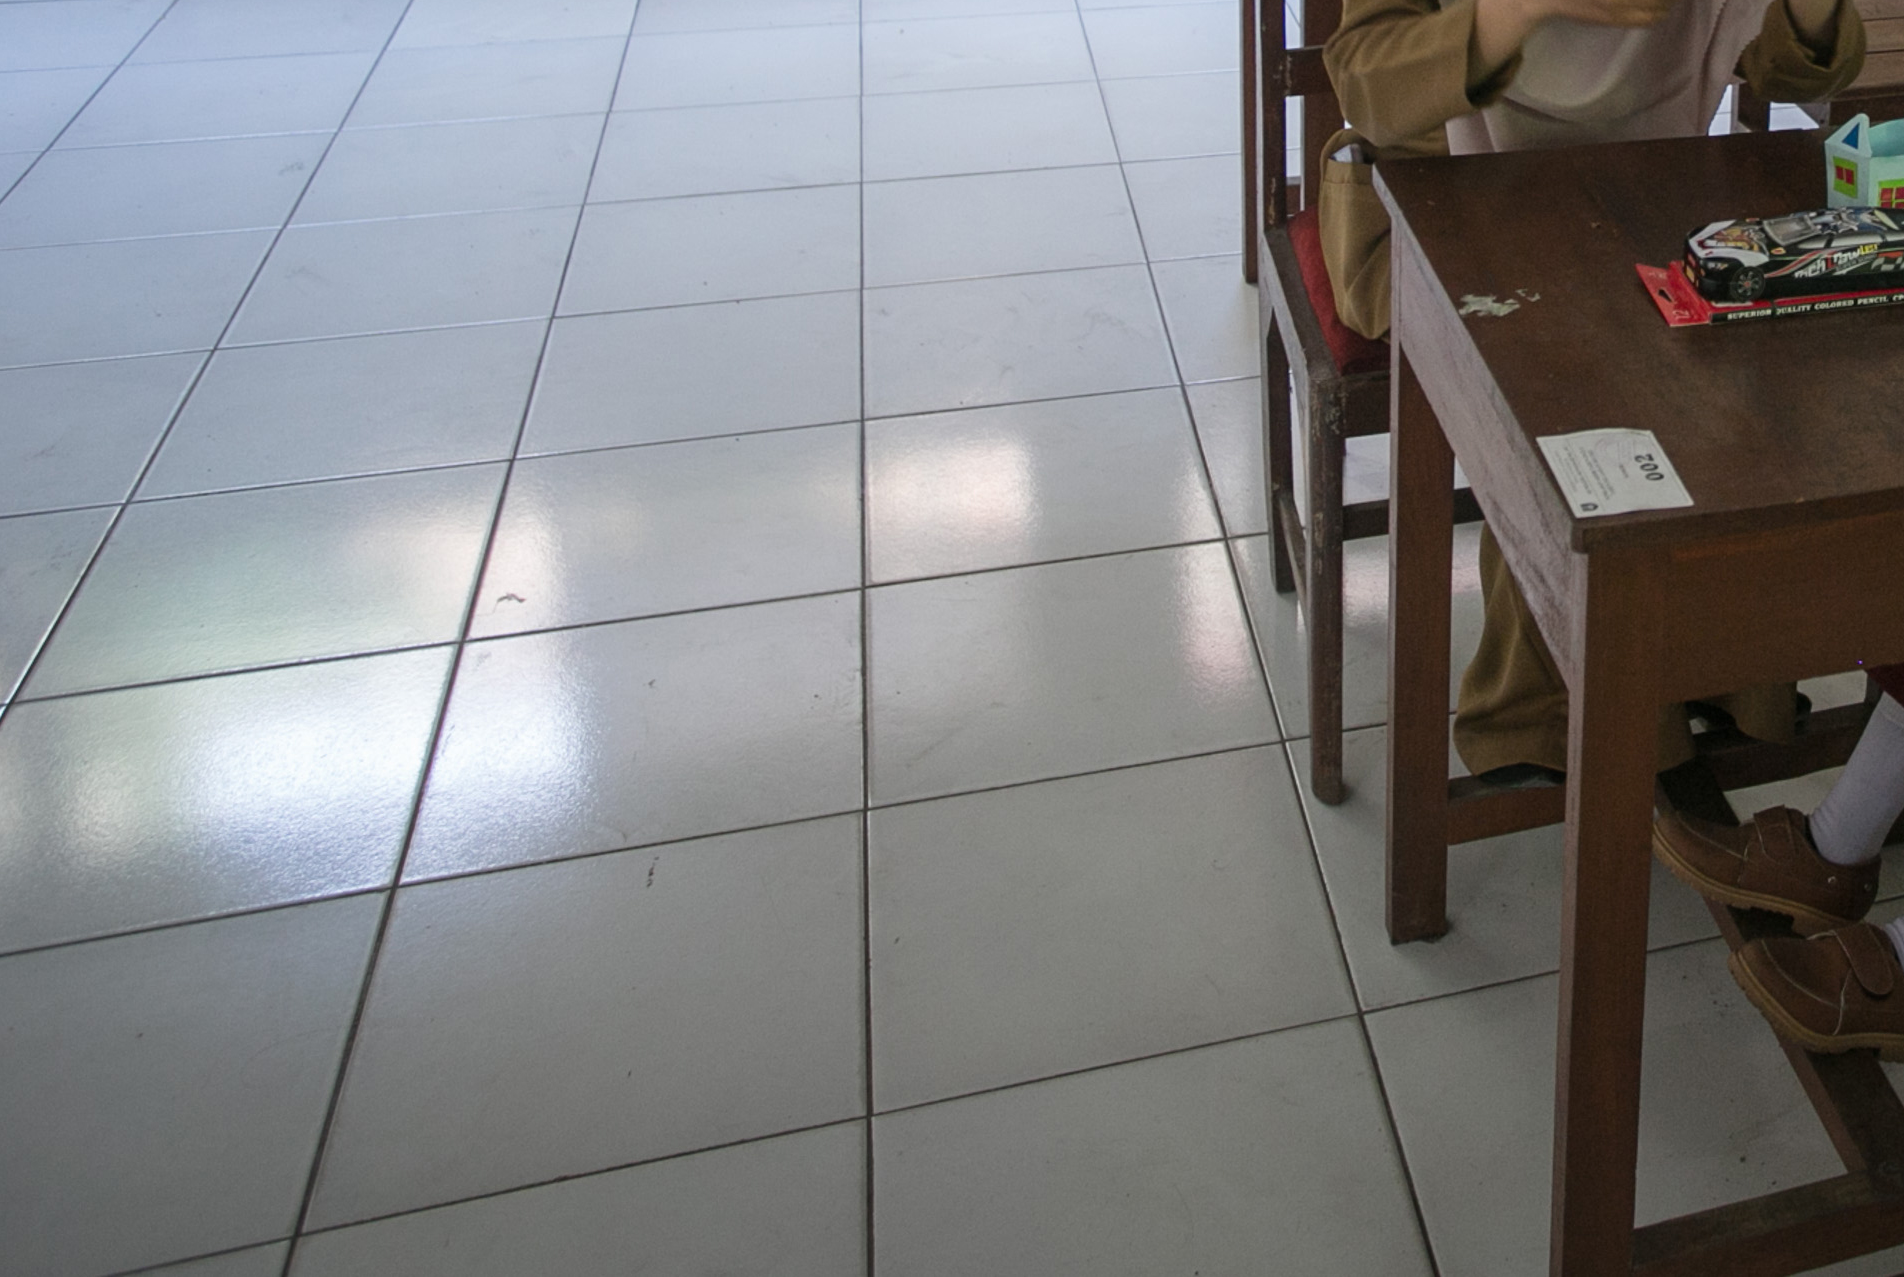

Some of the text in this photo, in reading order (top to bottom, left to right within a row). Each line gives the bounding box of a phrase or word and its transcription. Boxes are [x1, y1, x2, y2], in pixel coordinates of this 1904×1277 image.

[1727, 308, 1772, 321] SUPERIOR
[1814, 299, 1854, 310] COLORED
[1857, 295, 1889, 305] PENCIL
[1634, 453, 1665, 481] 002
